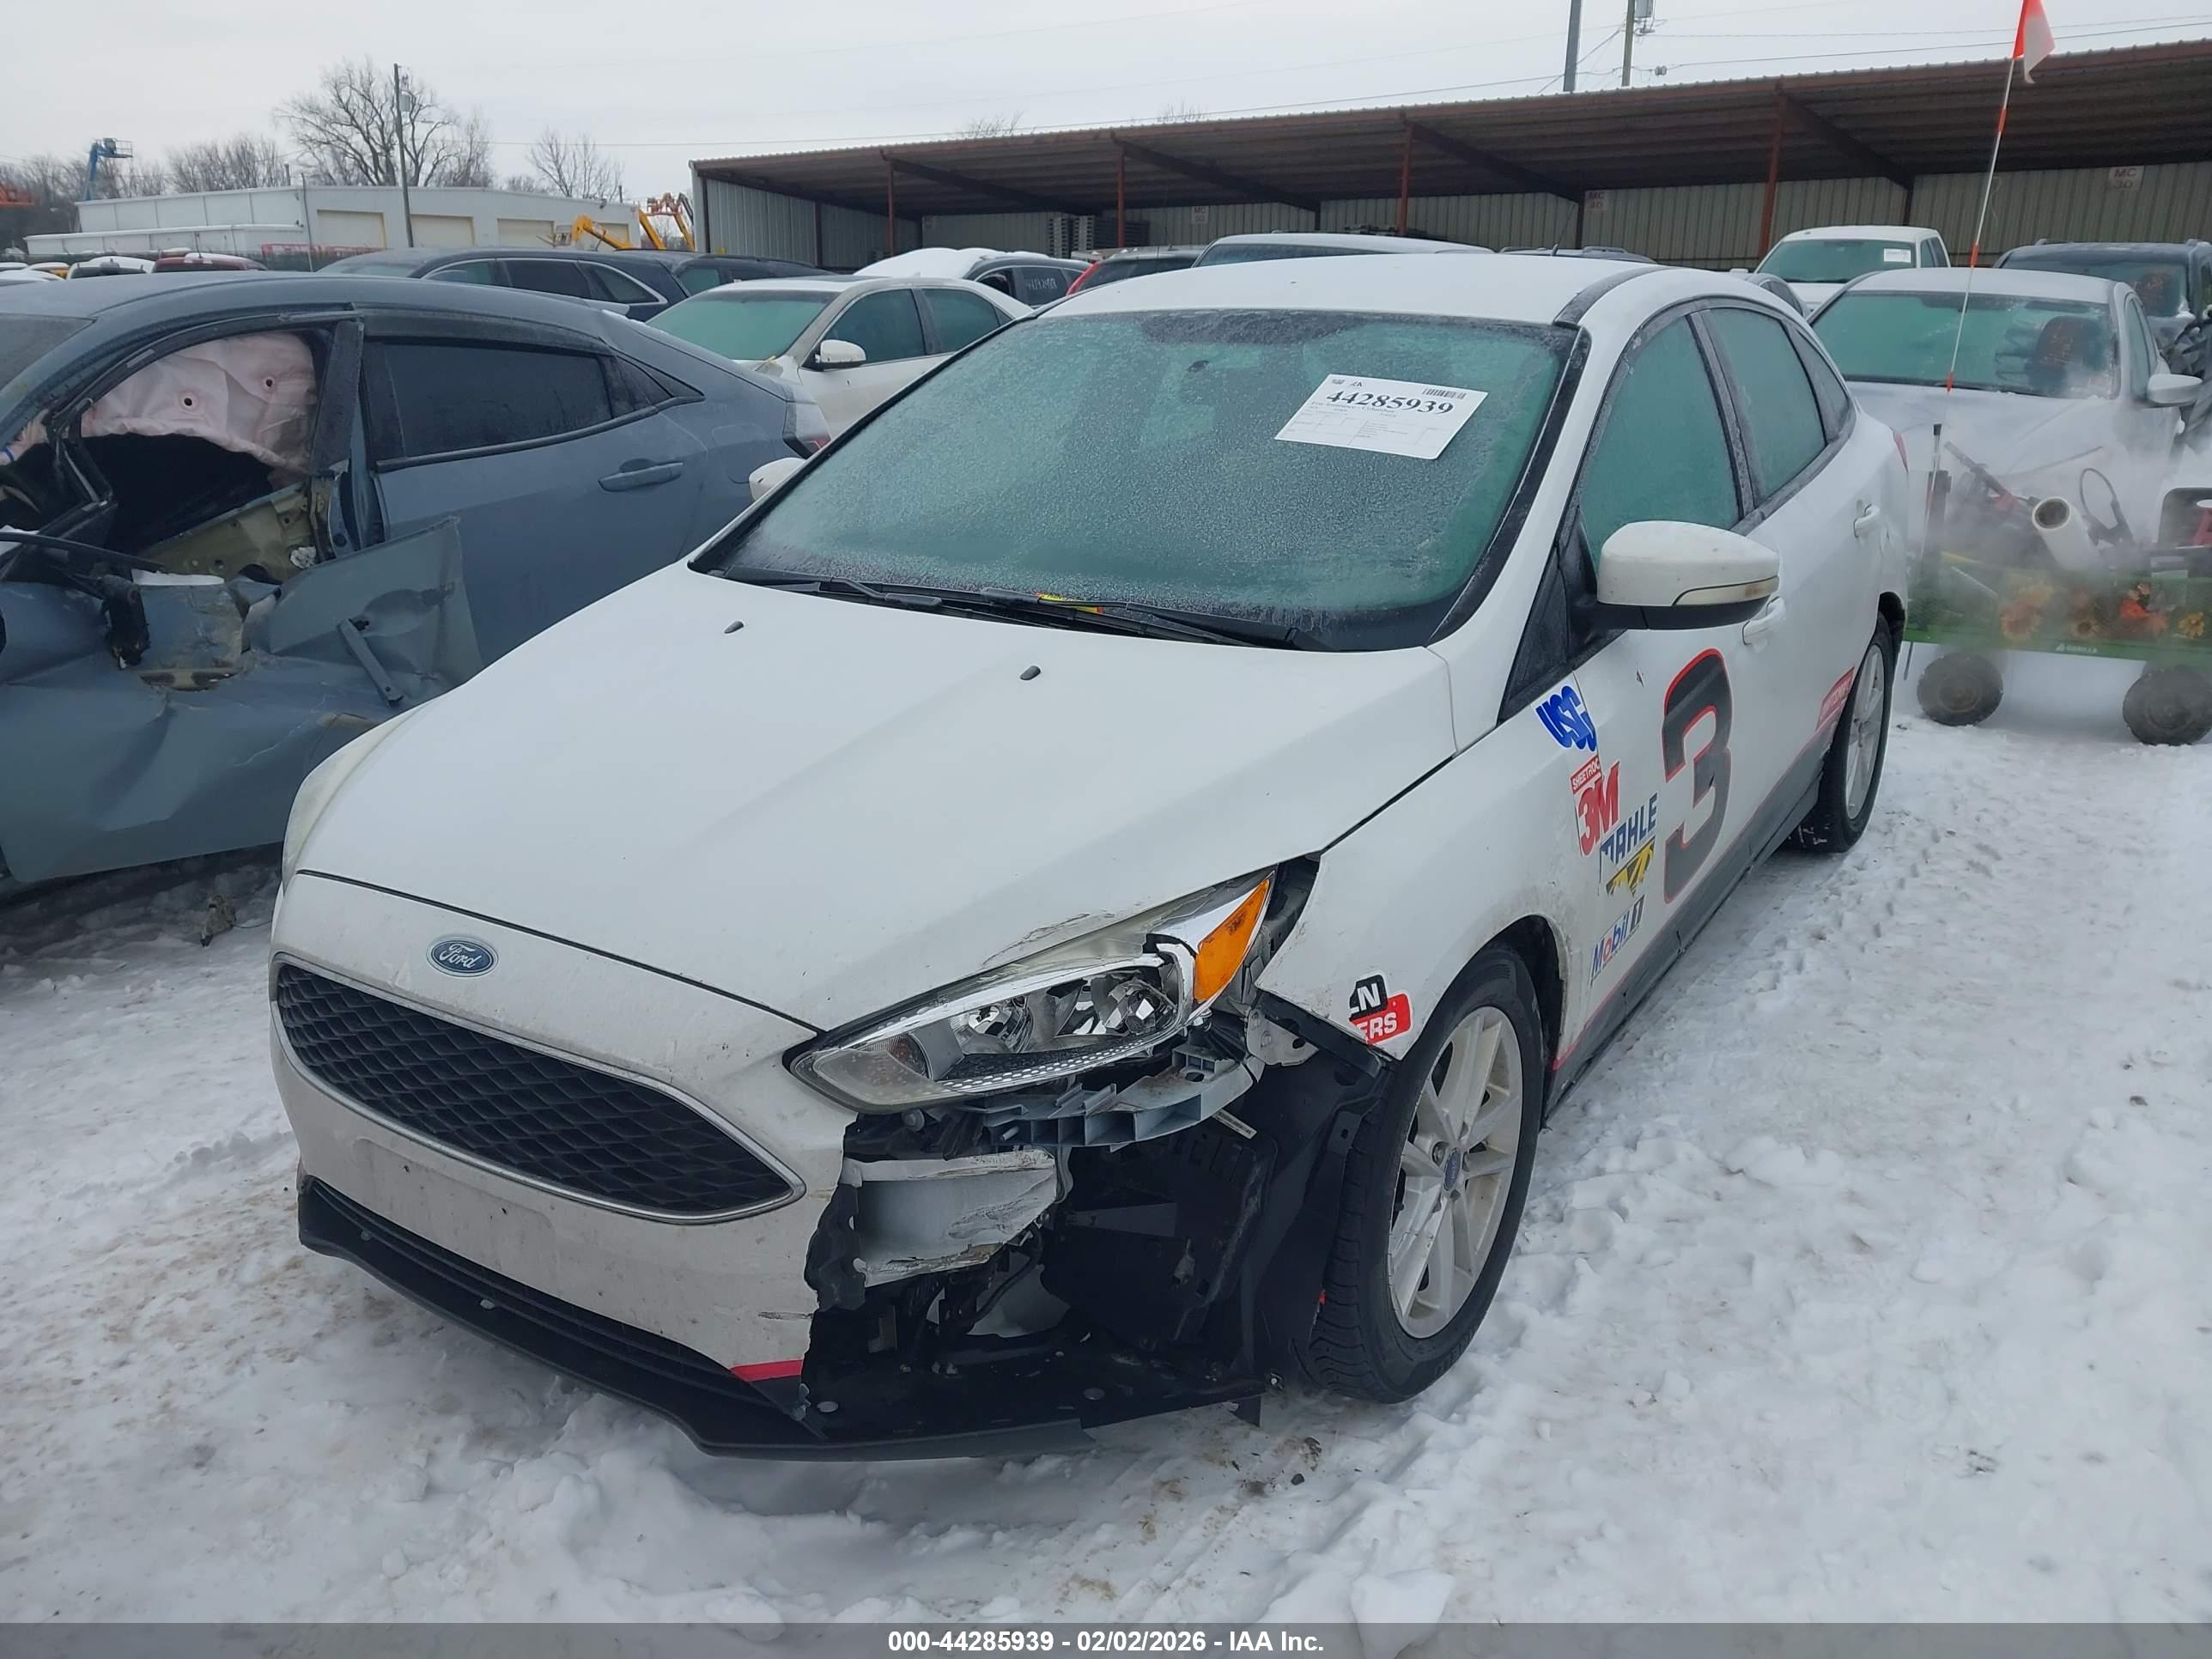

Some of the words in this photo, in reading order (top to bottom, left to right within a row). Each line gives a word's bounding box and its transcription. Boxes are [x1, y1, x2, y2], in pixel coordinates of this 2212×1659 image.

[2115, 167, 2136, 178] MC
[1326, 390, 1455, 415] 44285939
[1662, 647, 1733, 905] 3
[1578, 761, 1620, 856] 3M
[1600, 792, 1658, 866] MAHLE
[439, 943, 482, 969] Ford
[1591, 910, 1630, 978] Mobil
[1351, 982, 1382, 1012] N
